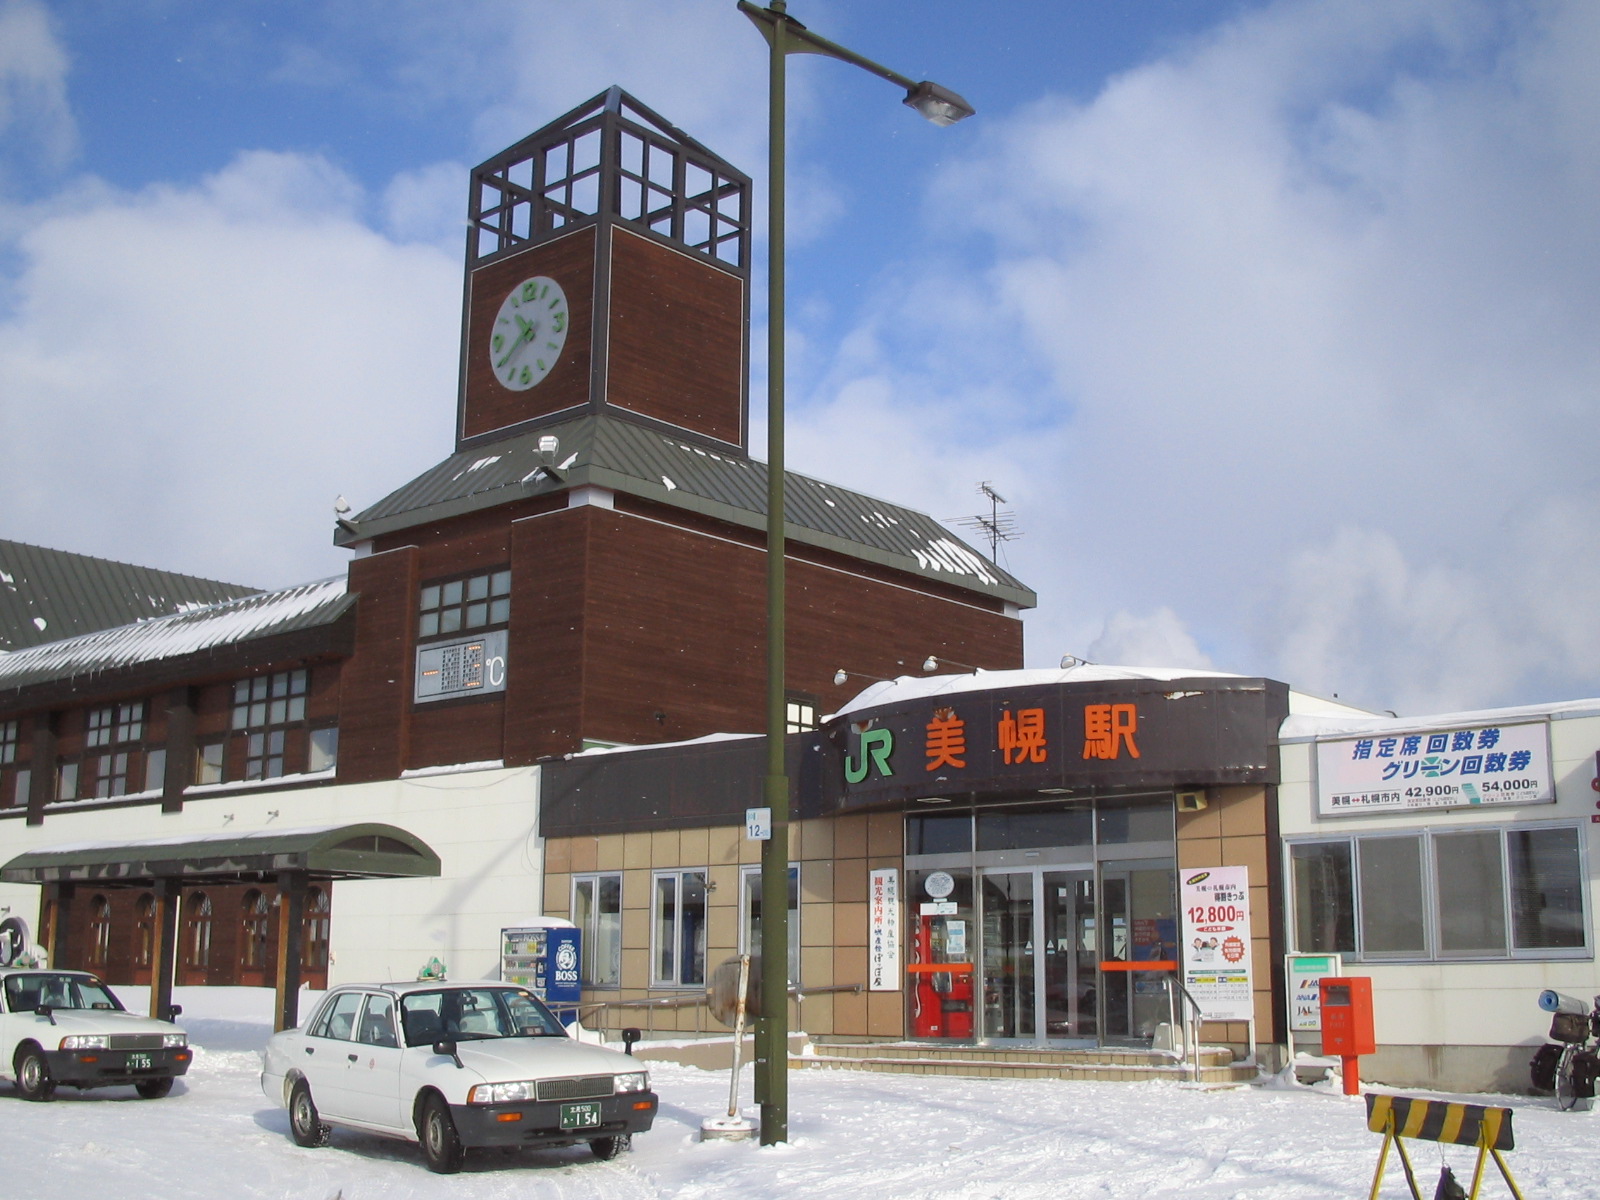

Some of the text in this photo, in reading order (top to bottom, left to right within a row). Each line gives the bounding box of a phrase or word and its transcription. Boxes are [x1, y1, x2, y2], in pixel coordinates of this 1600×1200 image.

[925, 703, 1140, 772] 美幌駅
[1352, 728, 1500, 761] 指定席回数券
[844, 728, 893, 784] JR
[1381, 750, 1531, 781] グリーン回数券
[1405, 784, 1459, 799] 42,900円
[1482, 778, 1538, 793] 54,000円
[1188, 905, 1244, 924] 12,800円
[555, 971, 578, 981] BOSS
[1297, 1006, 1312, 1015] JAL
